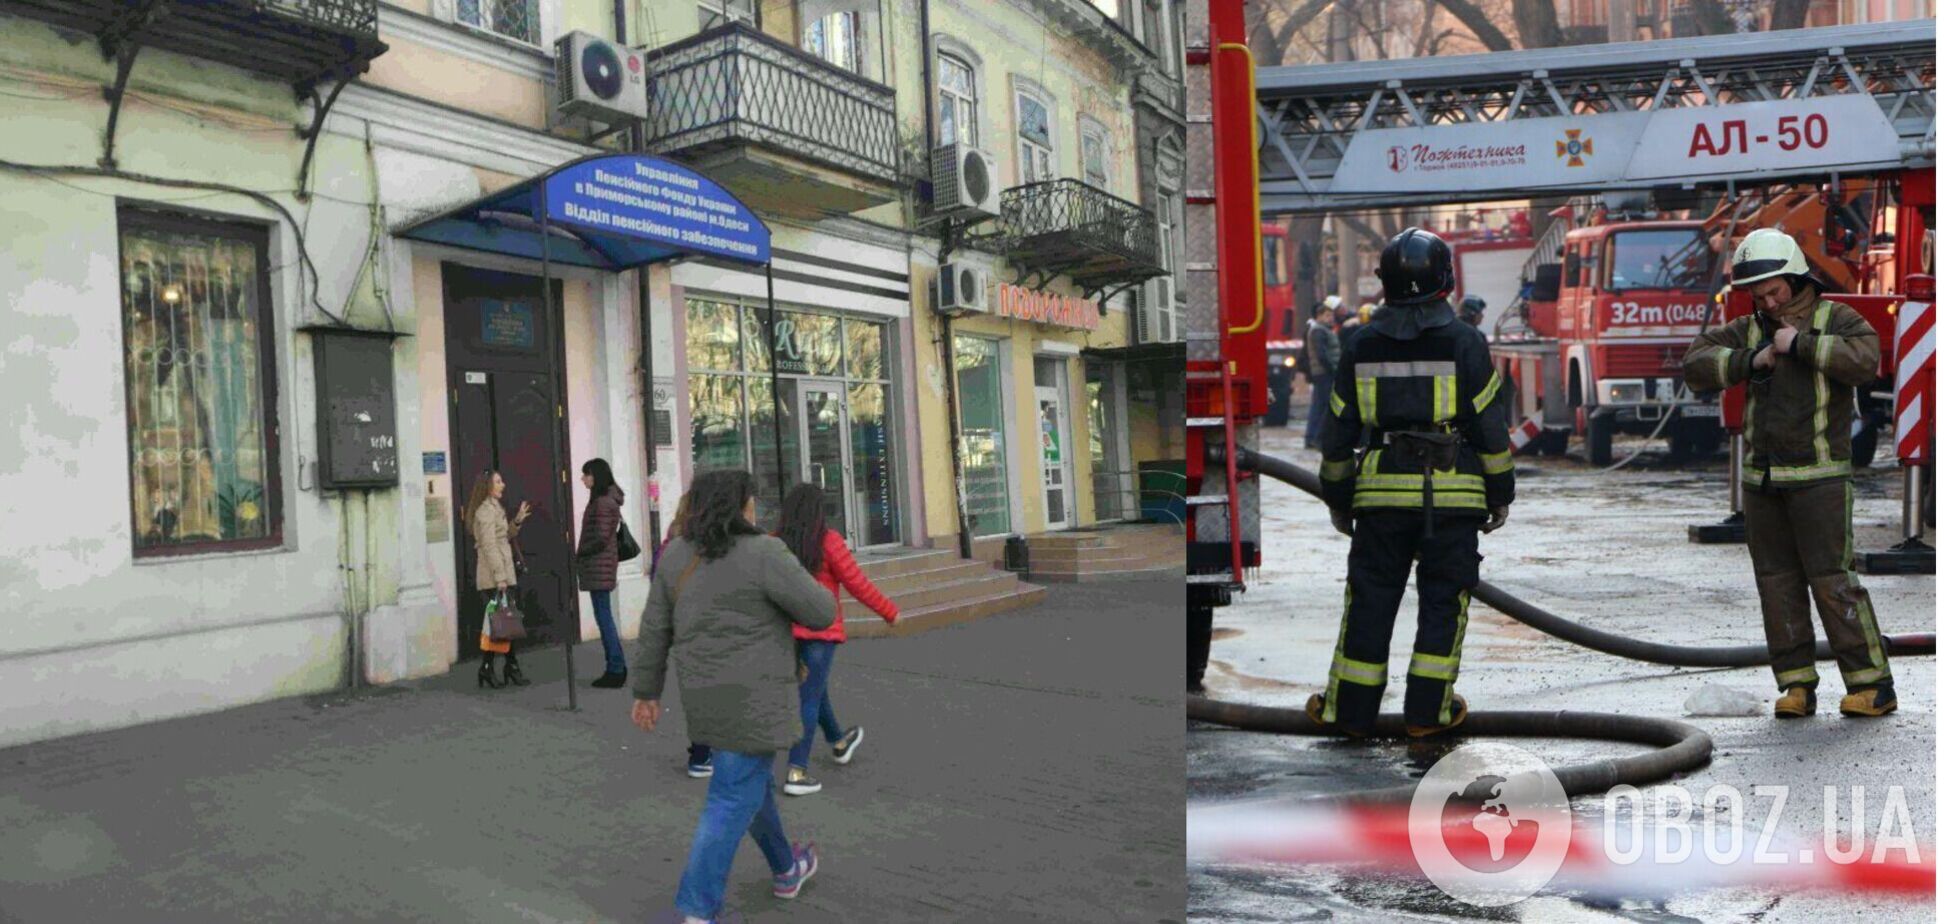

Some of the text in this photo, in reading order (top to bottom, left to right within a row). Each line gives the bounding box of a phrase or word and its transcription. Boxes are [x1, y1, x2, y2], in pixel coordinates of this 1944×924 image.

[1410, 144, 1527, 164] Пожтехника
[595, 169, 737, 215] Пенсійного Фонду України
[634, 161, 699, 190] Управління
[575, 182, 584, 194] в
[585, 183, 672, 215] Приморському
[672, 205, 709, 223] районі
[564, 202, 758, 255] Відділ пенсійного забезпечення
[1611, 301, 1663, 324] 32m
[879, 448, 890, 526] EXTENSIONS
